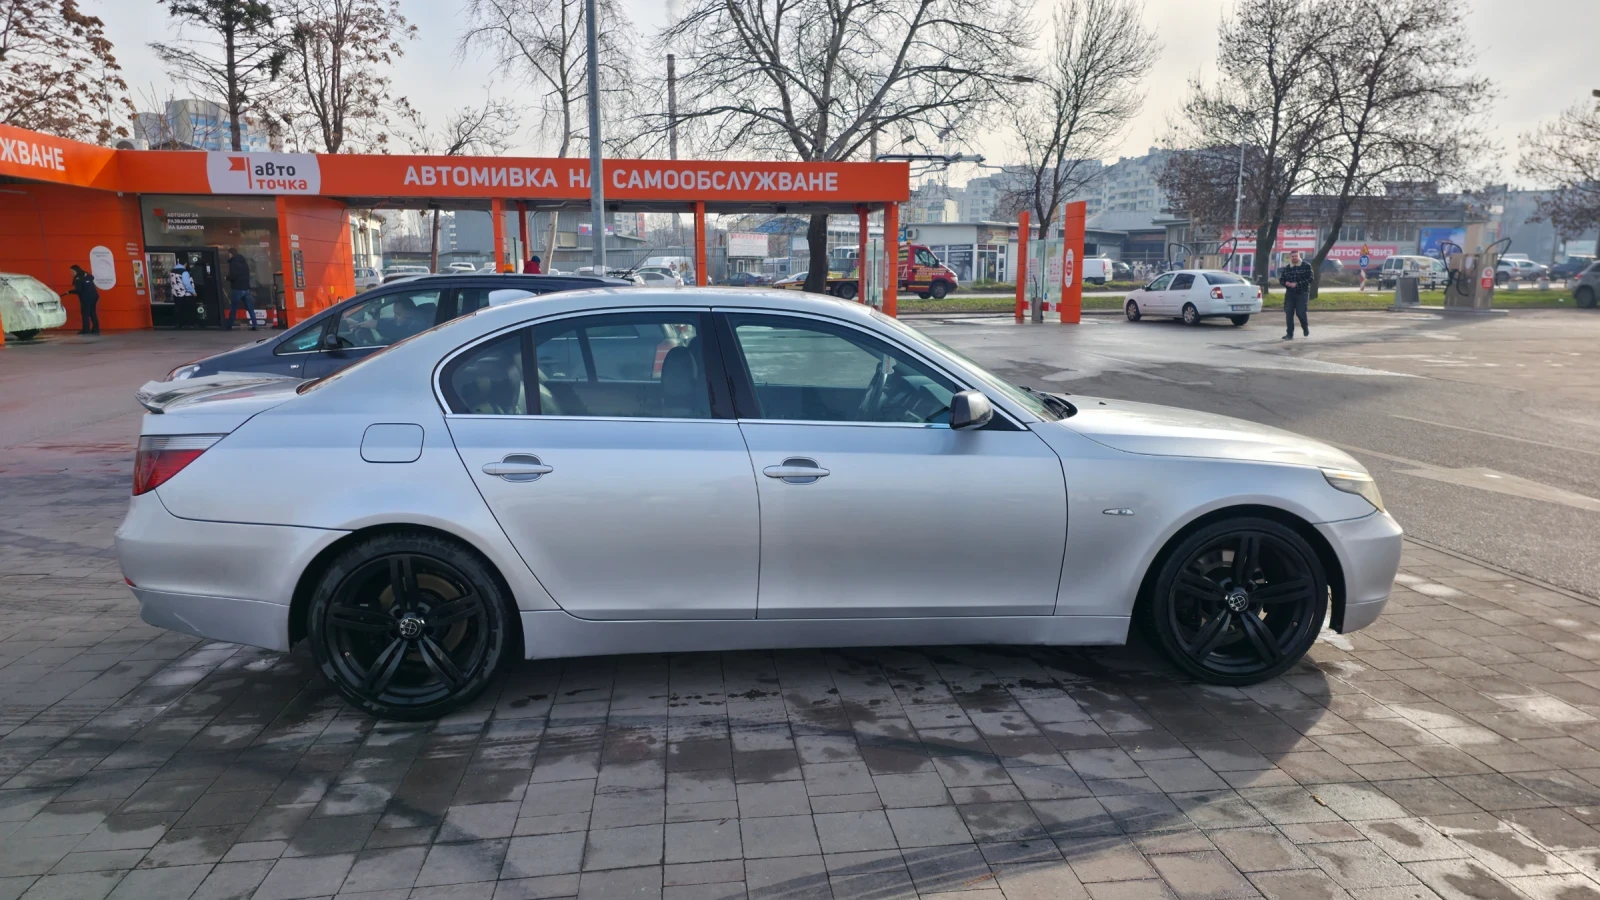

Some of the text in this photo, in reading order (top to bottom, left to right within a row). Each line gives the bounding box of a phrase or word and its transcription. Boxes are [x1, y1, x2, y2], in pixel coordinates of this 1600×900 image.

[0, 137, 66, 171] ЖВАНЕ
[255, 162, 296, 176] авто
[403, 165, 838, 191] АВТОМИВКА Н САМООБСЛУЖВАНЕ
[256, 179, 308, 190] точка
[1327, 248, 1394, 257] АВТОСРВИЗ
[1360, 257, 1368, 266] 30
